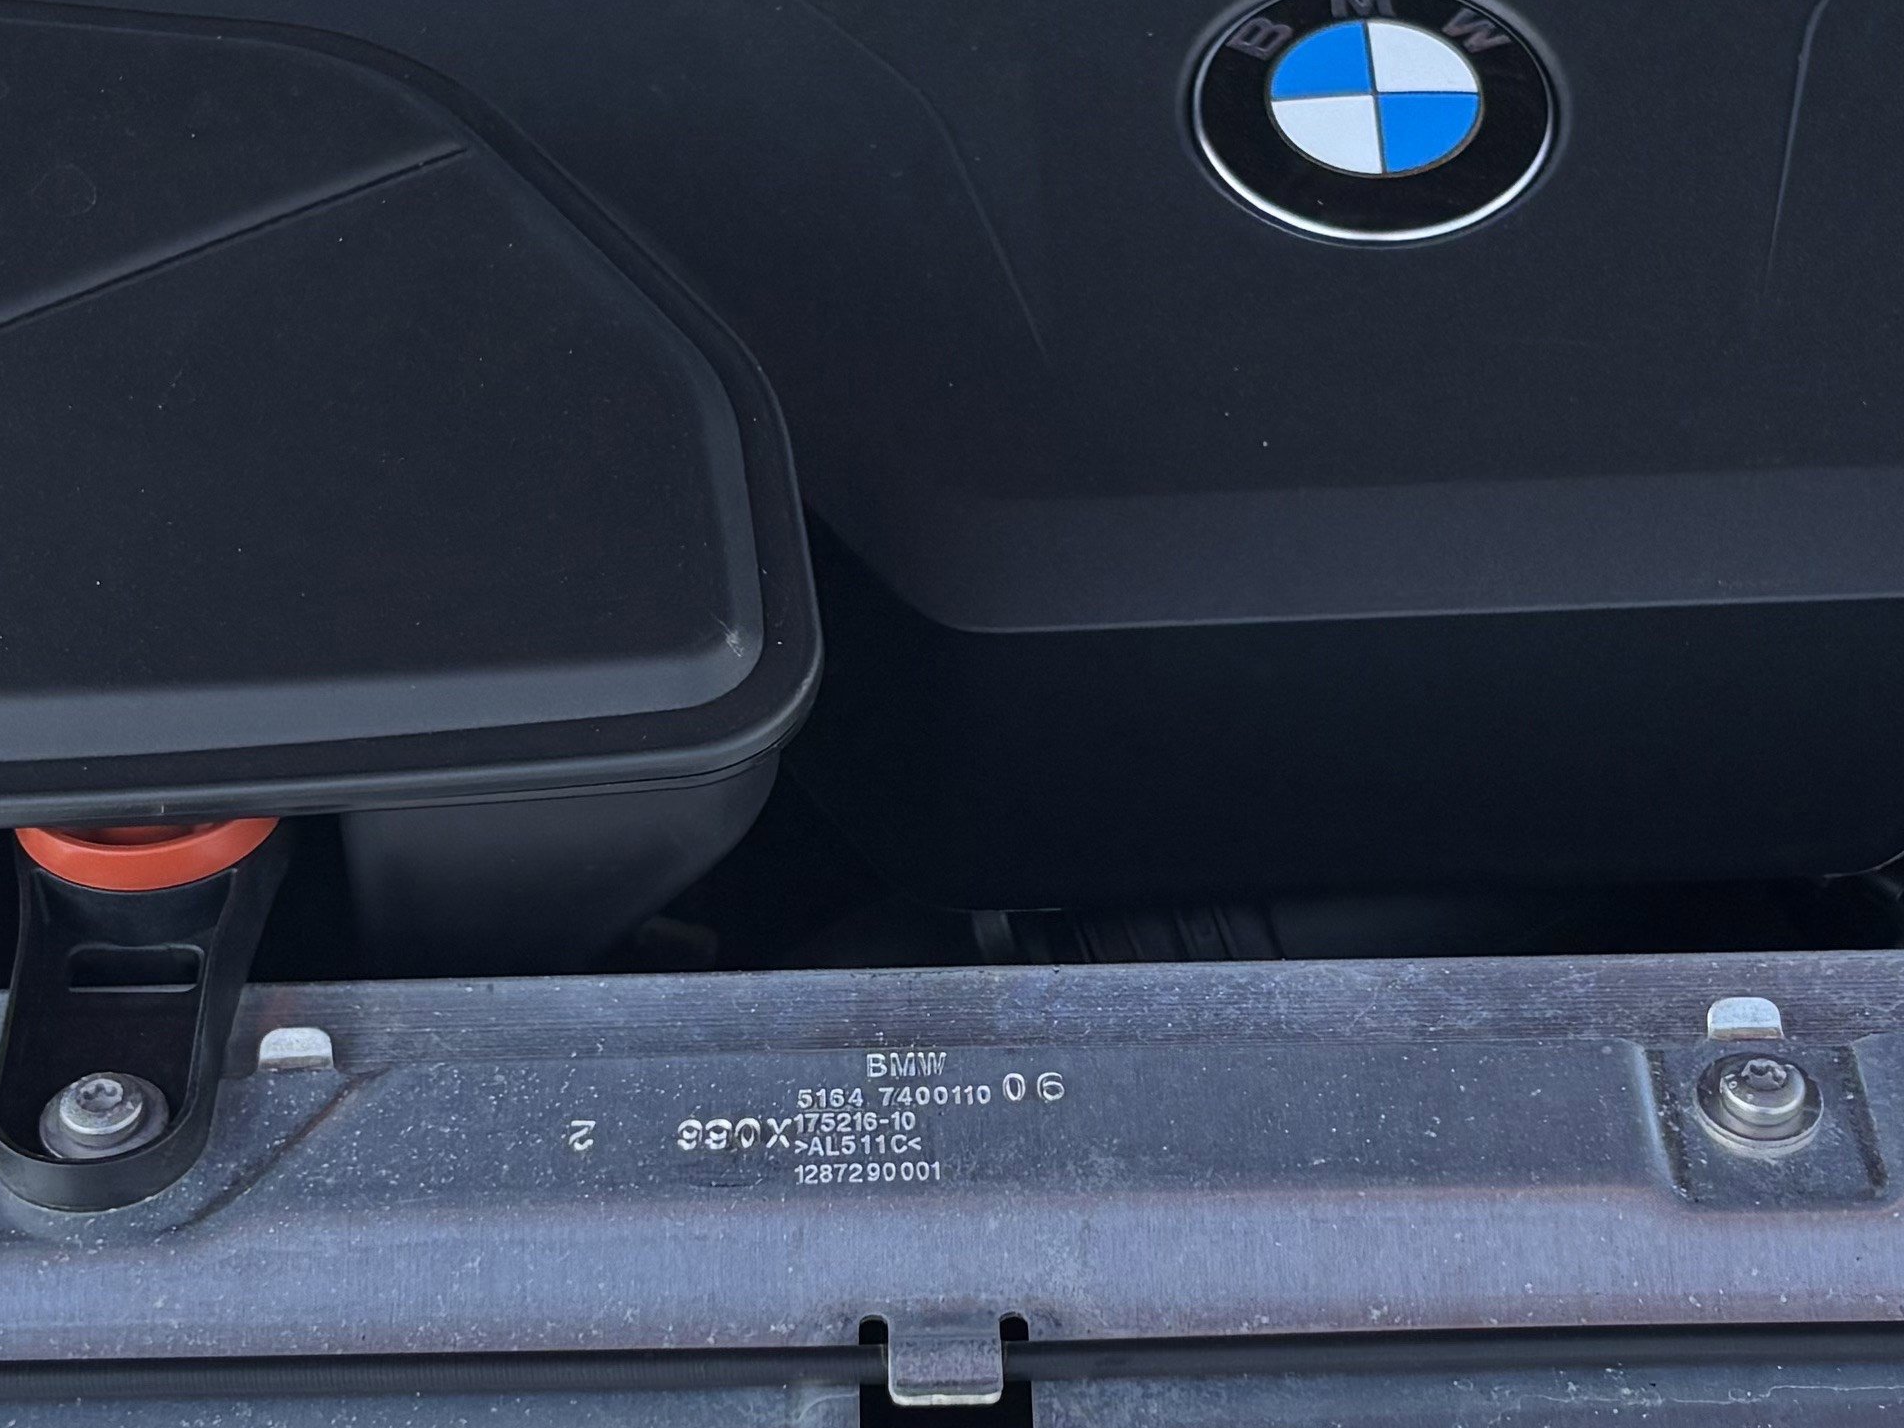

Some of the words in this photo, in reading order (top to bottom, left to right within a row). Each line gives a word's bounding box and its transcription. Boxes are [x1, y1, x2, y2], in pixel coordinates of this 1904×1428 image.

[866, 1051, 947, 1078] BMW
[797, 1087, 864, 1109] 5164
[878, 1084, 992, 1108] 7400110
[794, 1111, 916, 1133] 175216-10
[794, 1135, 922, 1157] >AL511C<
[794, 1161, 942, 1185] 1287290001
